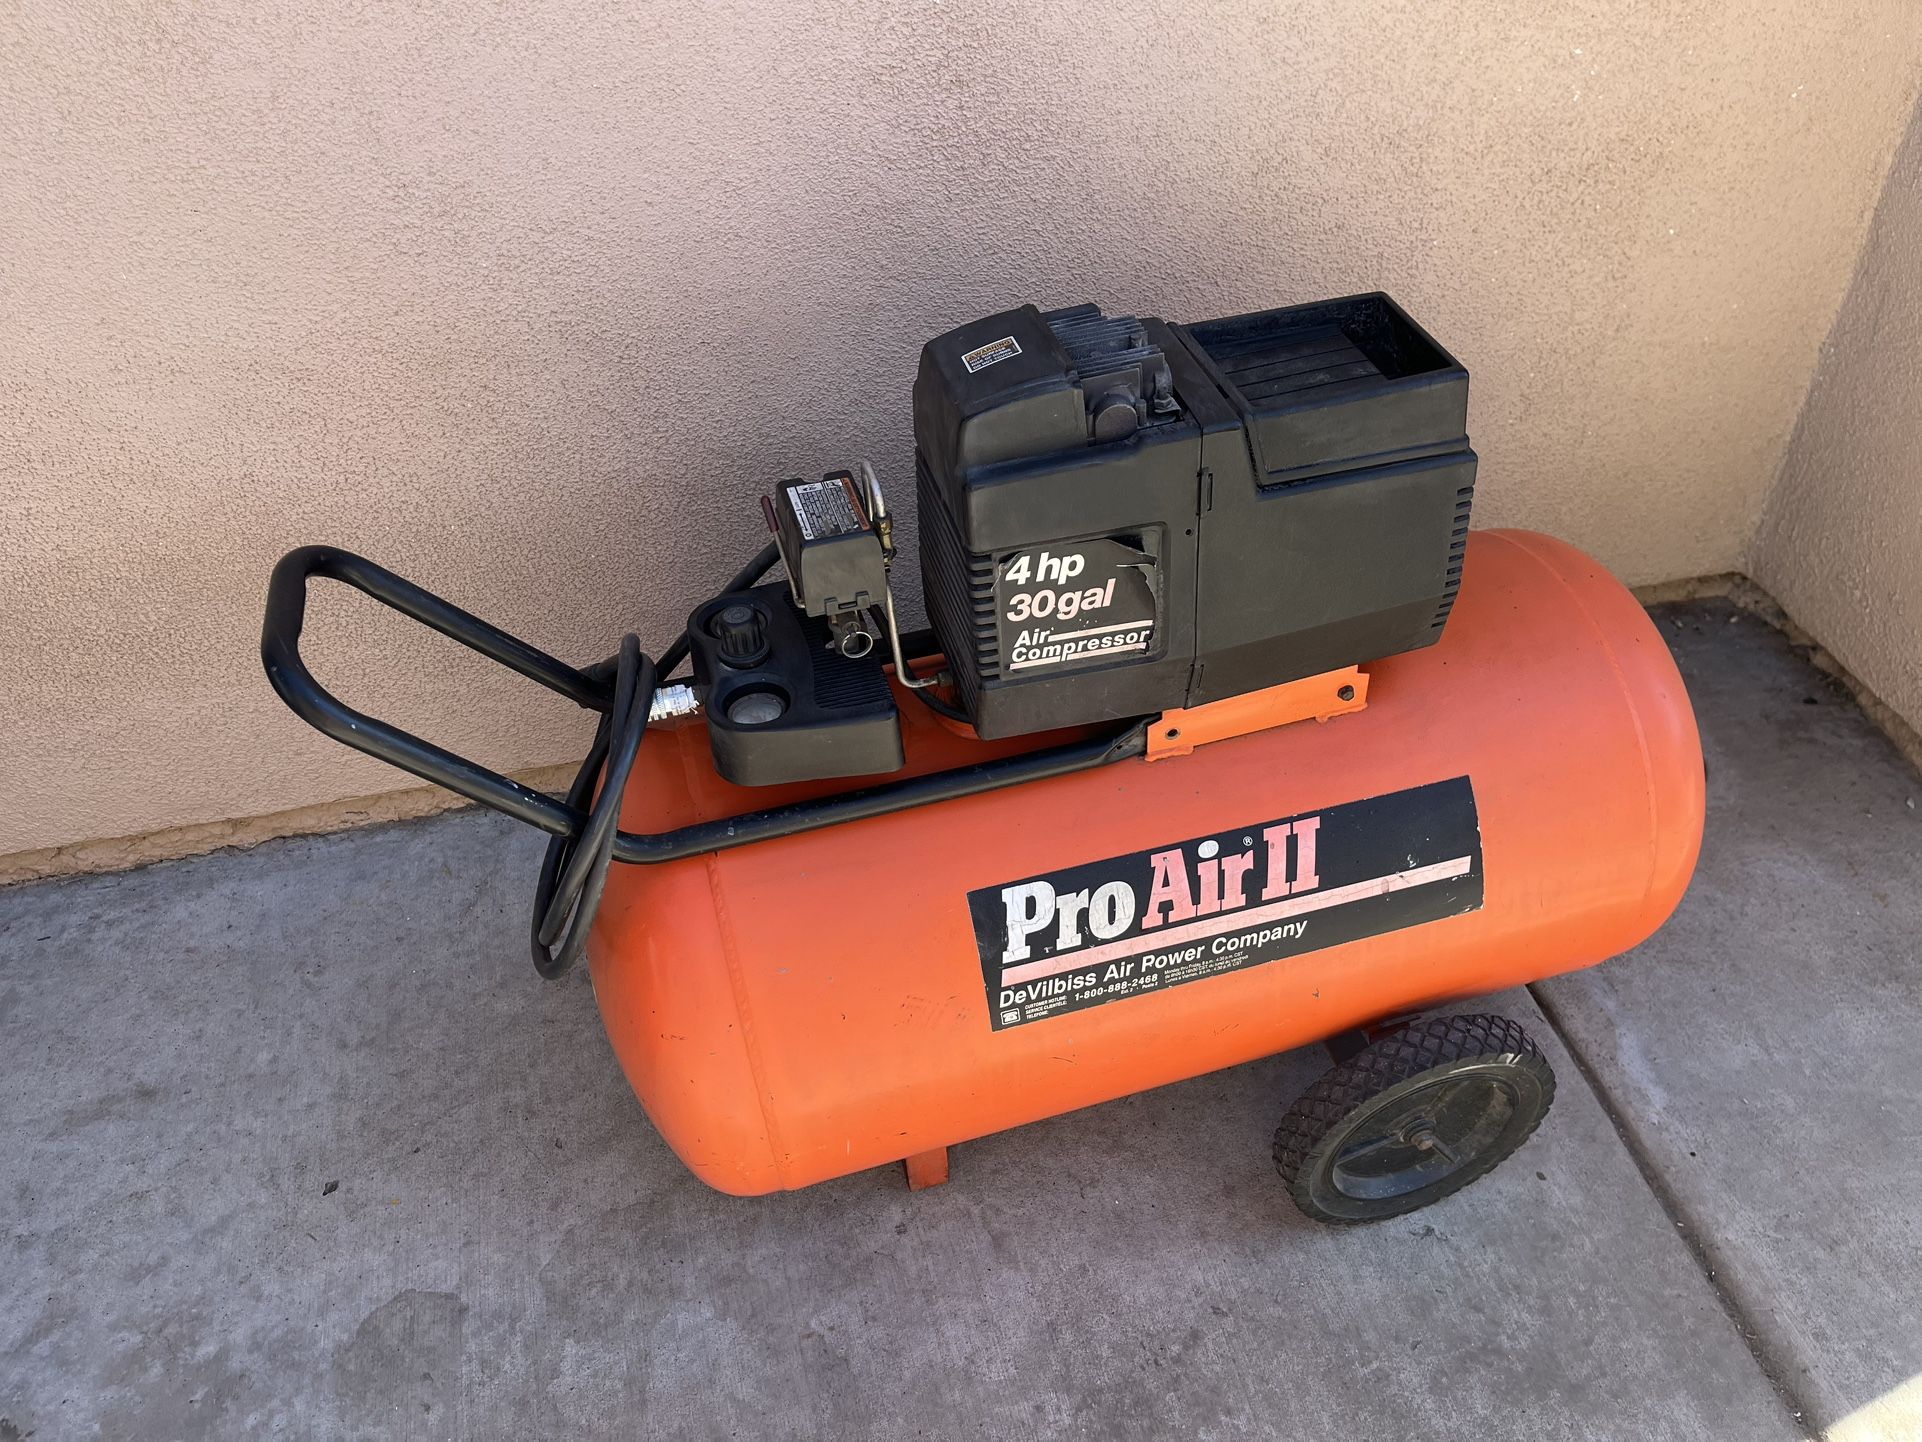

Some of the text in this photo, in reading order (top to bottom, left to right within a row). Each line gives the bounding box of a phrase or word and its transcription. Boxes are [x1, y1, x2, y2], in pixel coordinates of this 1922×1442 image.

[1005, 552, 1085, 585] 4 hp
[1006, 578, 1117, 622] 30 gal
[1011, 628, 1150, 662] Air Compressor
[999, 920, 1308, 1009] DeVilbiss Air Power Company
[1074, 973, 1158, 1001] 1-800-888-2468
